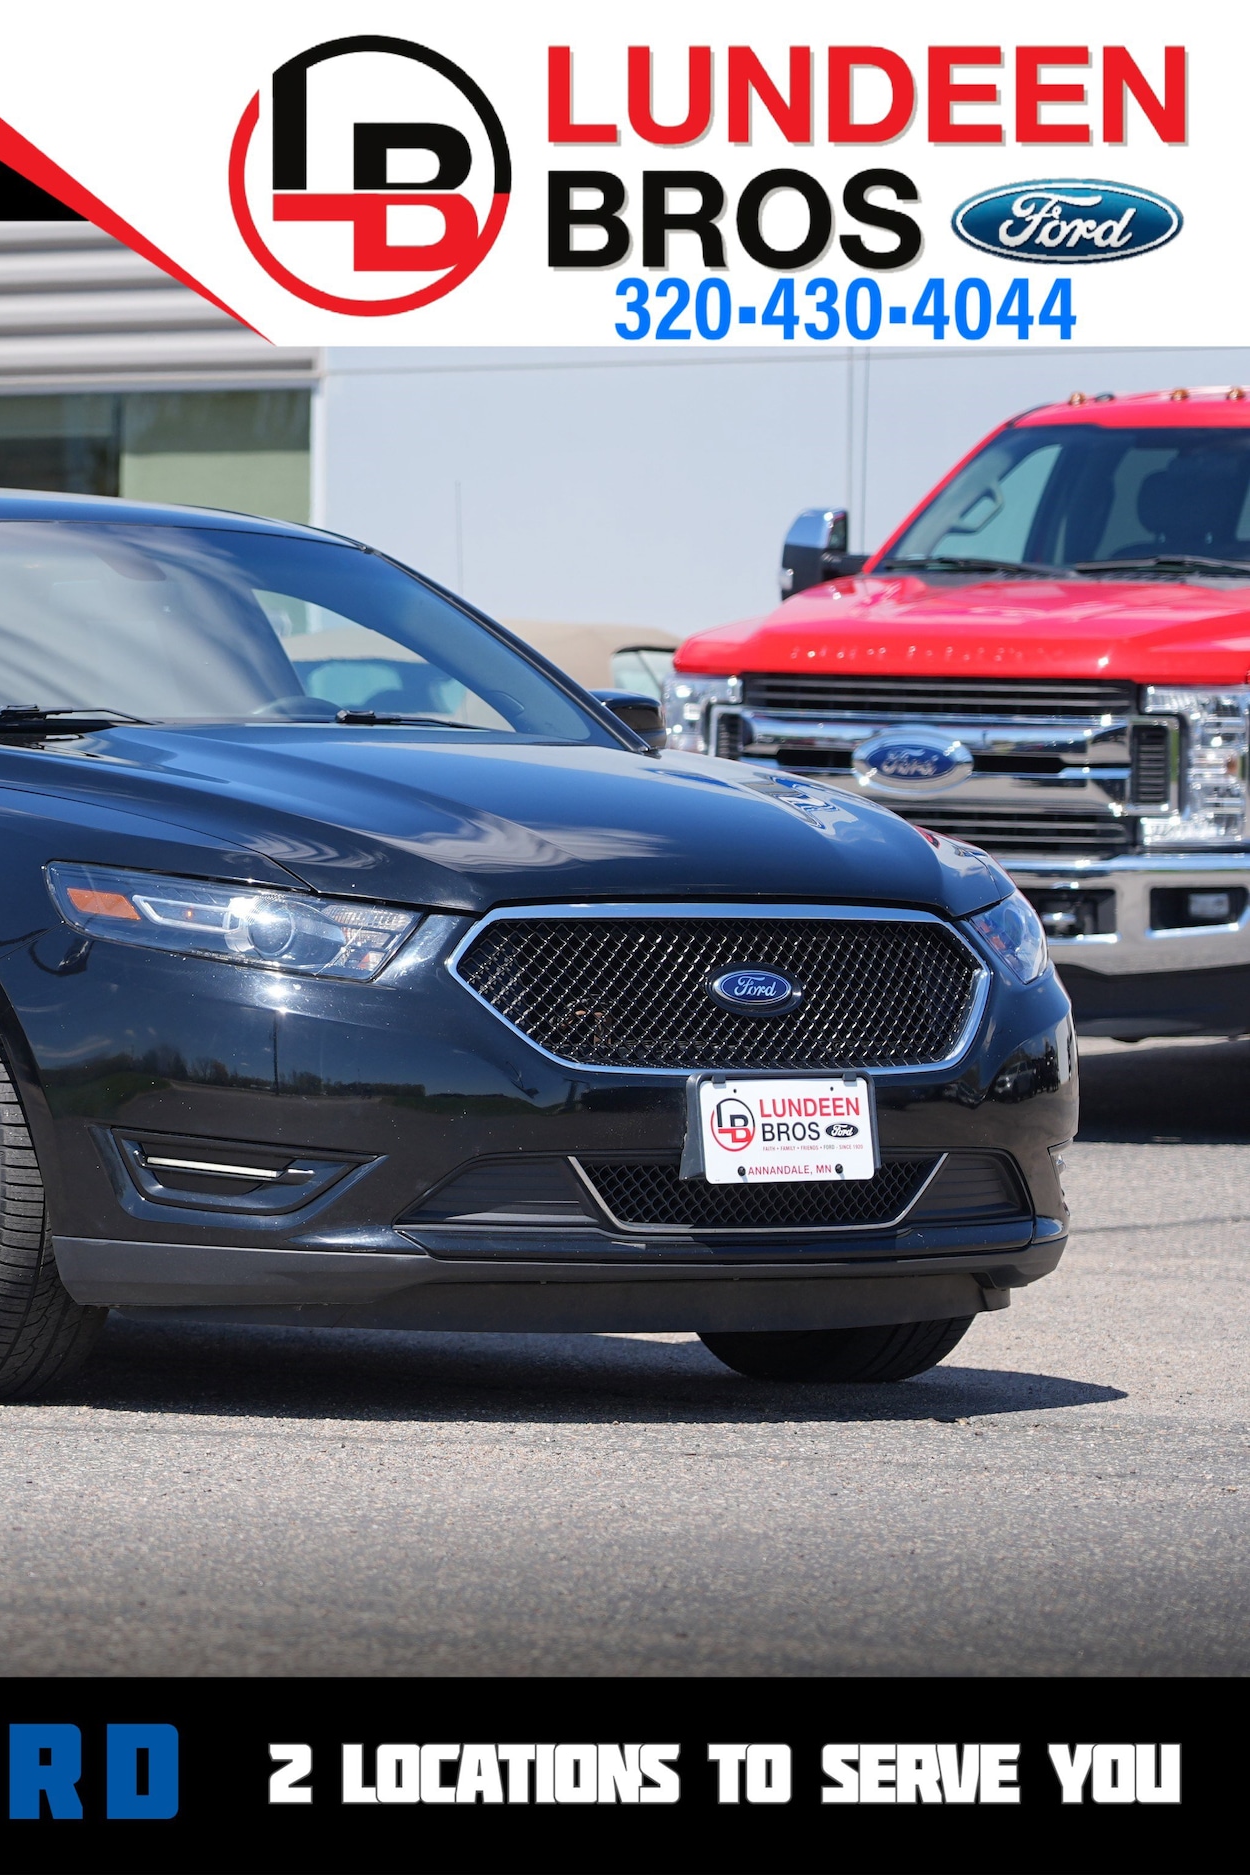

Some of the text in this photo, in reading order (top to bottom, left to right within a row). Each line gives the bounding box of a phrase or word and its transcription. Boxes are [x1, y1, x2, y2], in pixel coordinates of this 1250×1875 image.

[734, 975, 777, 997] Ford
[759, 1097, 860, 1118] LUNDEEN
[761, 1121, 821, 1142] BROS
[831, 1124, 854, 1138] Ford
[748, 1164, 832, 1175] ANNANDALE, MN
